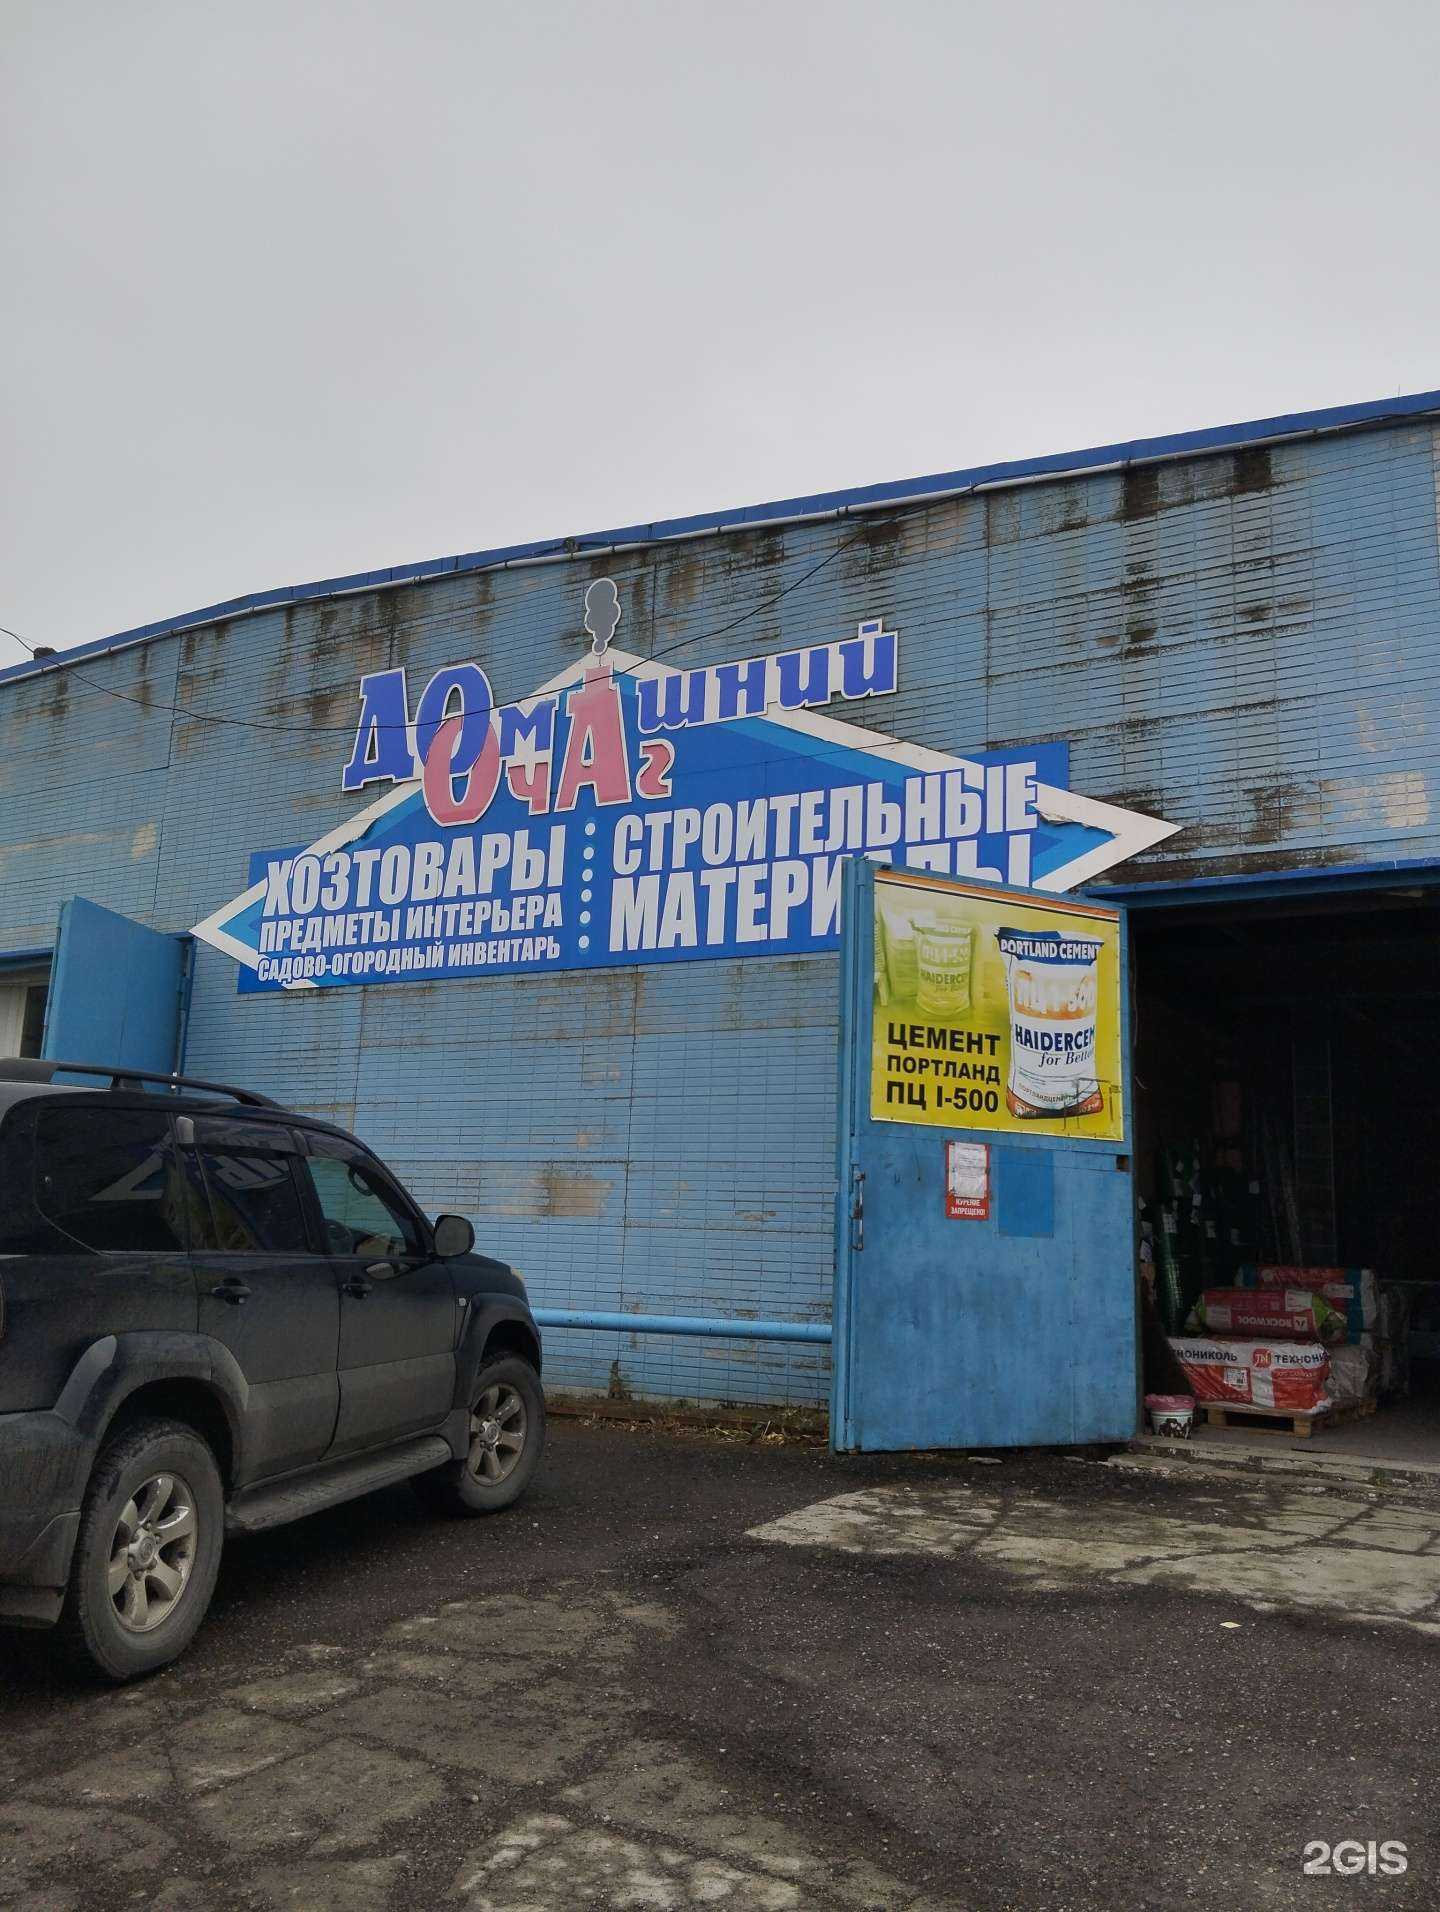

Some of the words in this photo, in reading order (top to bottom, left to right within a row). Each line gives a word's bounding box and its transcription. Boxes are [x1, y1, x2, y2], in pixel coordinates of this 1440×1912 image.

[613, 761, 1037, 875] СТРОИТЕЛЬНЫЕ
[263, 824, 566, 916] ХОЗТОВАРЫ
[259, 908, 401, 954] ПРЕДМЕТЫ
[405, 892, 563, 940] ИНТЕРЬЕРА
[257, 941, 445, 983] САДОВО-ОГОРОДНЫЙ
[447, 935, 561, 967] ИНВЕНТАРЬ
[1000, 939, 1058, 958] PORTLAND
[888, 1022, 1001, 1056] ЦЕМЕНТ
[887, 1054, 1000, 1086] ПОРТЛАНД
[1038, 1051, 1061, 1067] for
[887, 1080, 926, 1111] ПЦ
[937, 1085, 999, 1113] I-500
